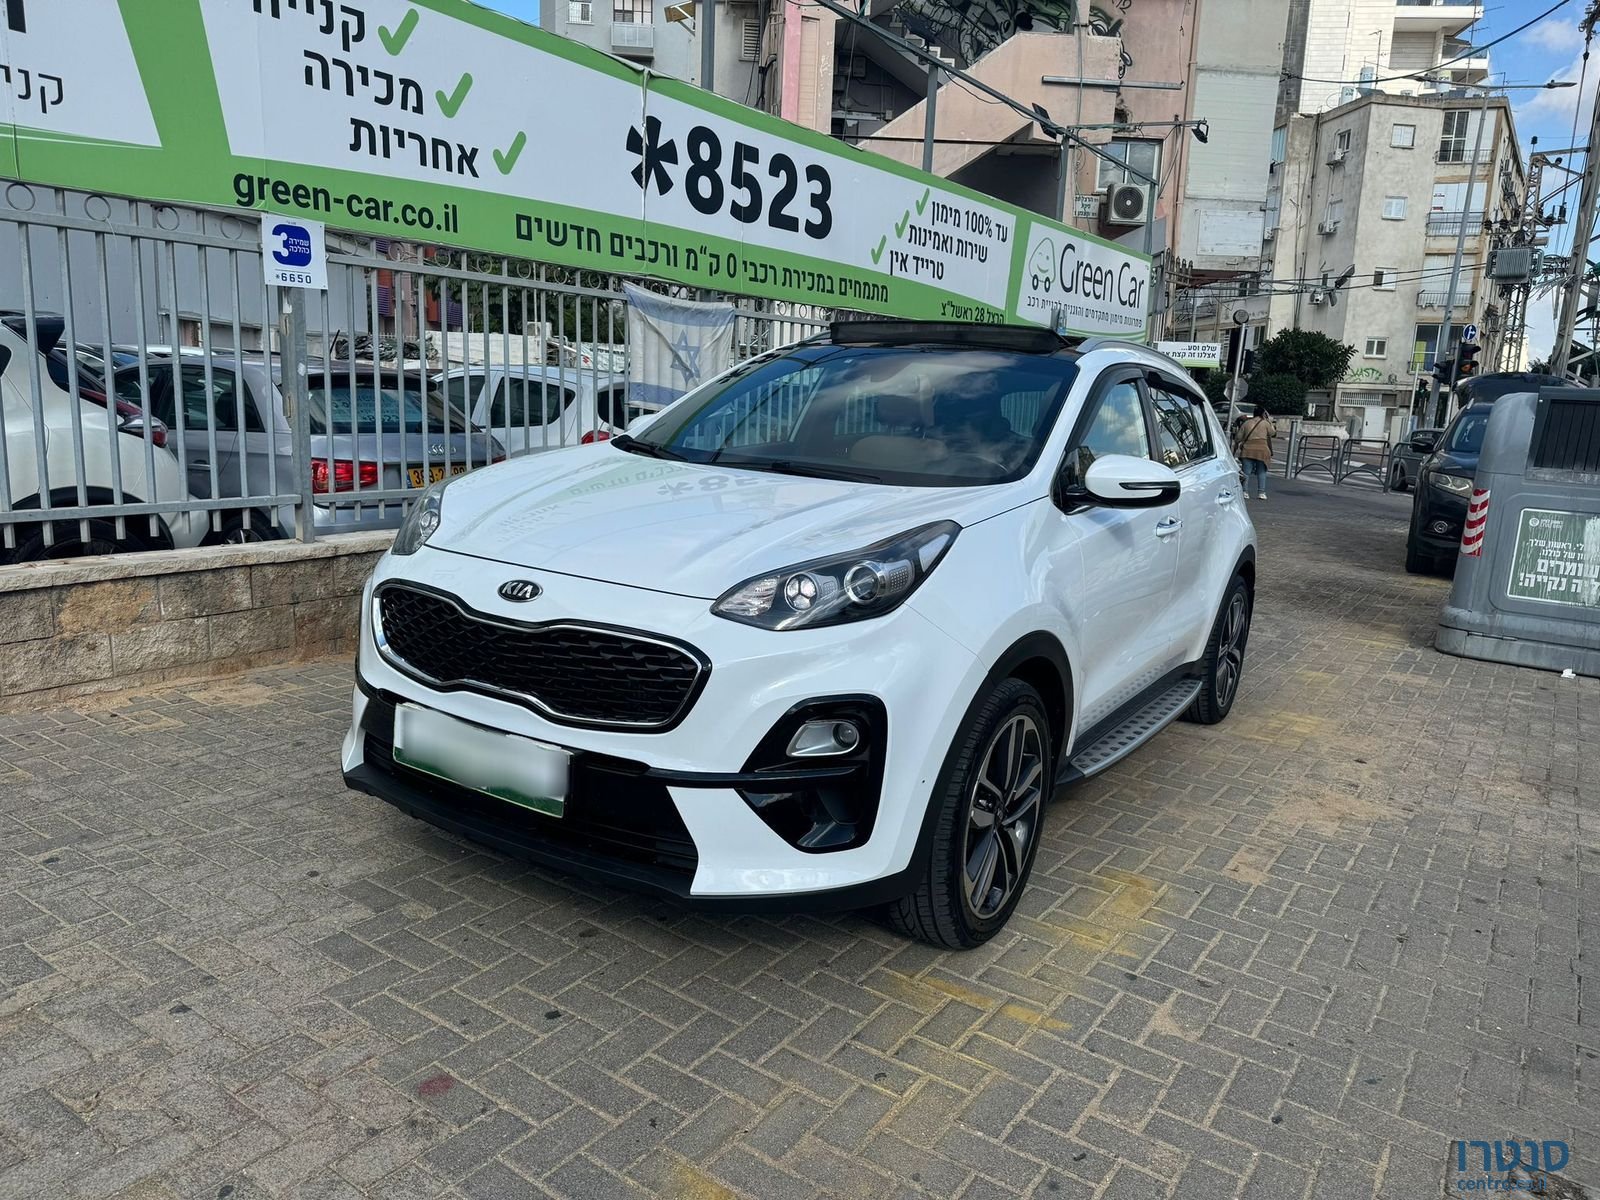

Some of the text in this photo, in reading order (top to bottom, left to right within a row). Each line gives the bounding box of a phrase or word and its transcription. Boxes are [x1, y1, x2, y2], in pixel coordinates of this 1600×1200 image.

[303, 49, 424, 116] מכירה
[349, 117, 480, 178] אחריות
[233, 171, 458, 233] green-car.co.il
[515, 212, 601, 255] חדשים
[931, 200, 1008, 244] עד 100% מימון
[288, 237, 310, 247] שמירה
[288, 245, 310, 255] כהלכה
[609, 231, 678, 269] ורכבים
[908, 222, 988, 264] שירות ואמינות
[726, 253, 737, 280] 0
[742, 260, 778, 287] רכבי
[888, 249, 945, 281] טרייד אין
[1059, 243, 1146, 311] Green Car
[781, 268, 835, 296] במכירת
[838, 277, 890, 304] מתמחים
[974, 306, 986, 323] 28
[1027, 295, 1040, 308] רכב
[986, 307, 1005, 325] הרצל
[1171, 351, 1187, 359] קצת
[1197, 351, 1217, 359] אצלנו
[1201, 344, 1218, 352] שלם
[501, 581, 533, 599] KIA
